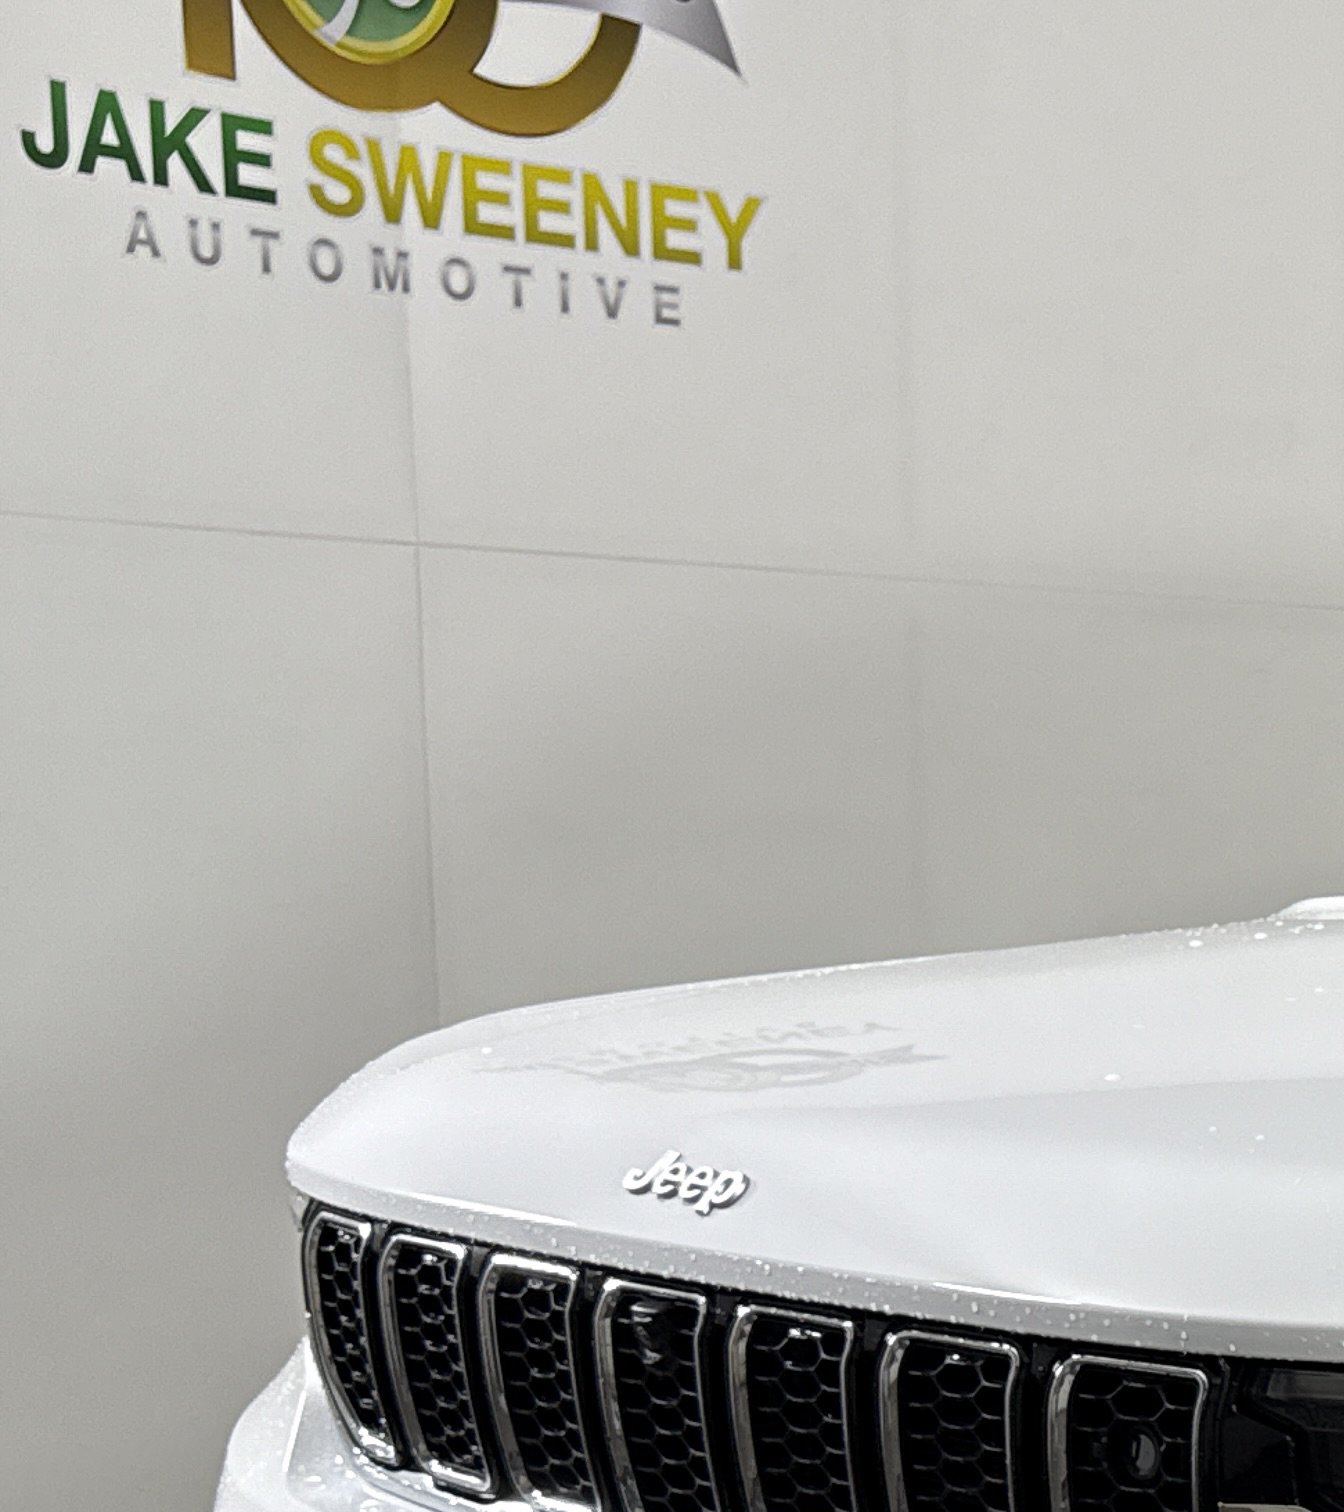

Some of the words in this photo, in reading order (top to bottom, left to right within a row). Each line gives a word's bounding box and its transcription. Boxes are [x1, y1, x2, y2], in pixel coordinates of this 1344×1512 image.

[20, 79, 278, 205] JAKE
[307, 128, 764, 271] SWEENEY
[124, 210, 682, 327] AUTOMOTIVE
[621, 1149, 751, 1217] Jeep
